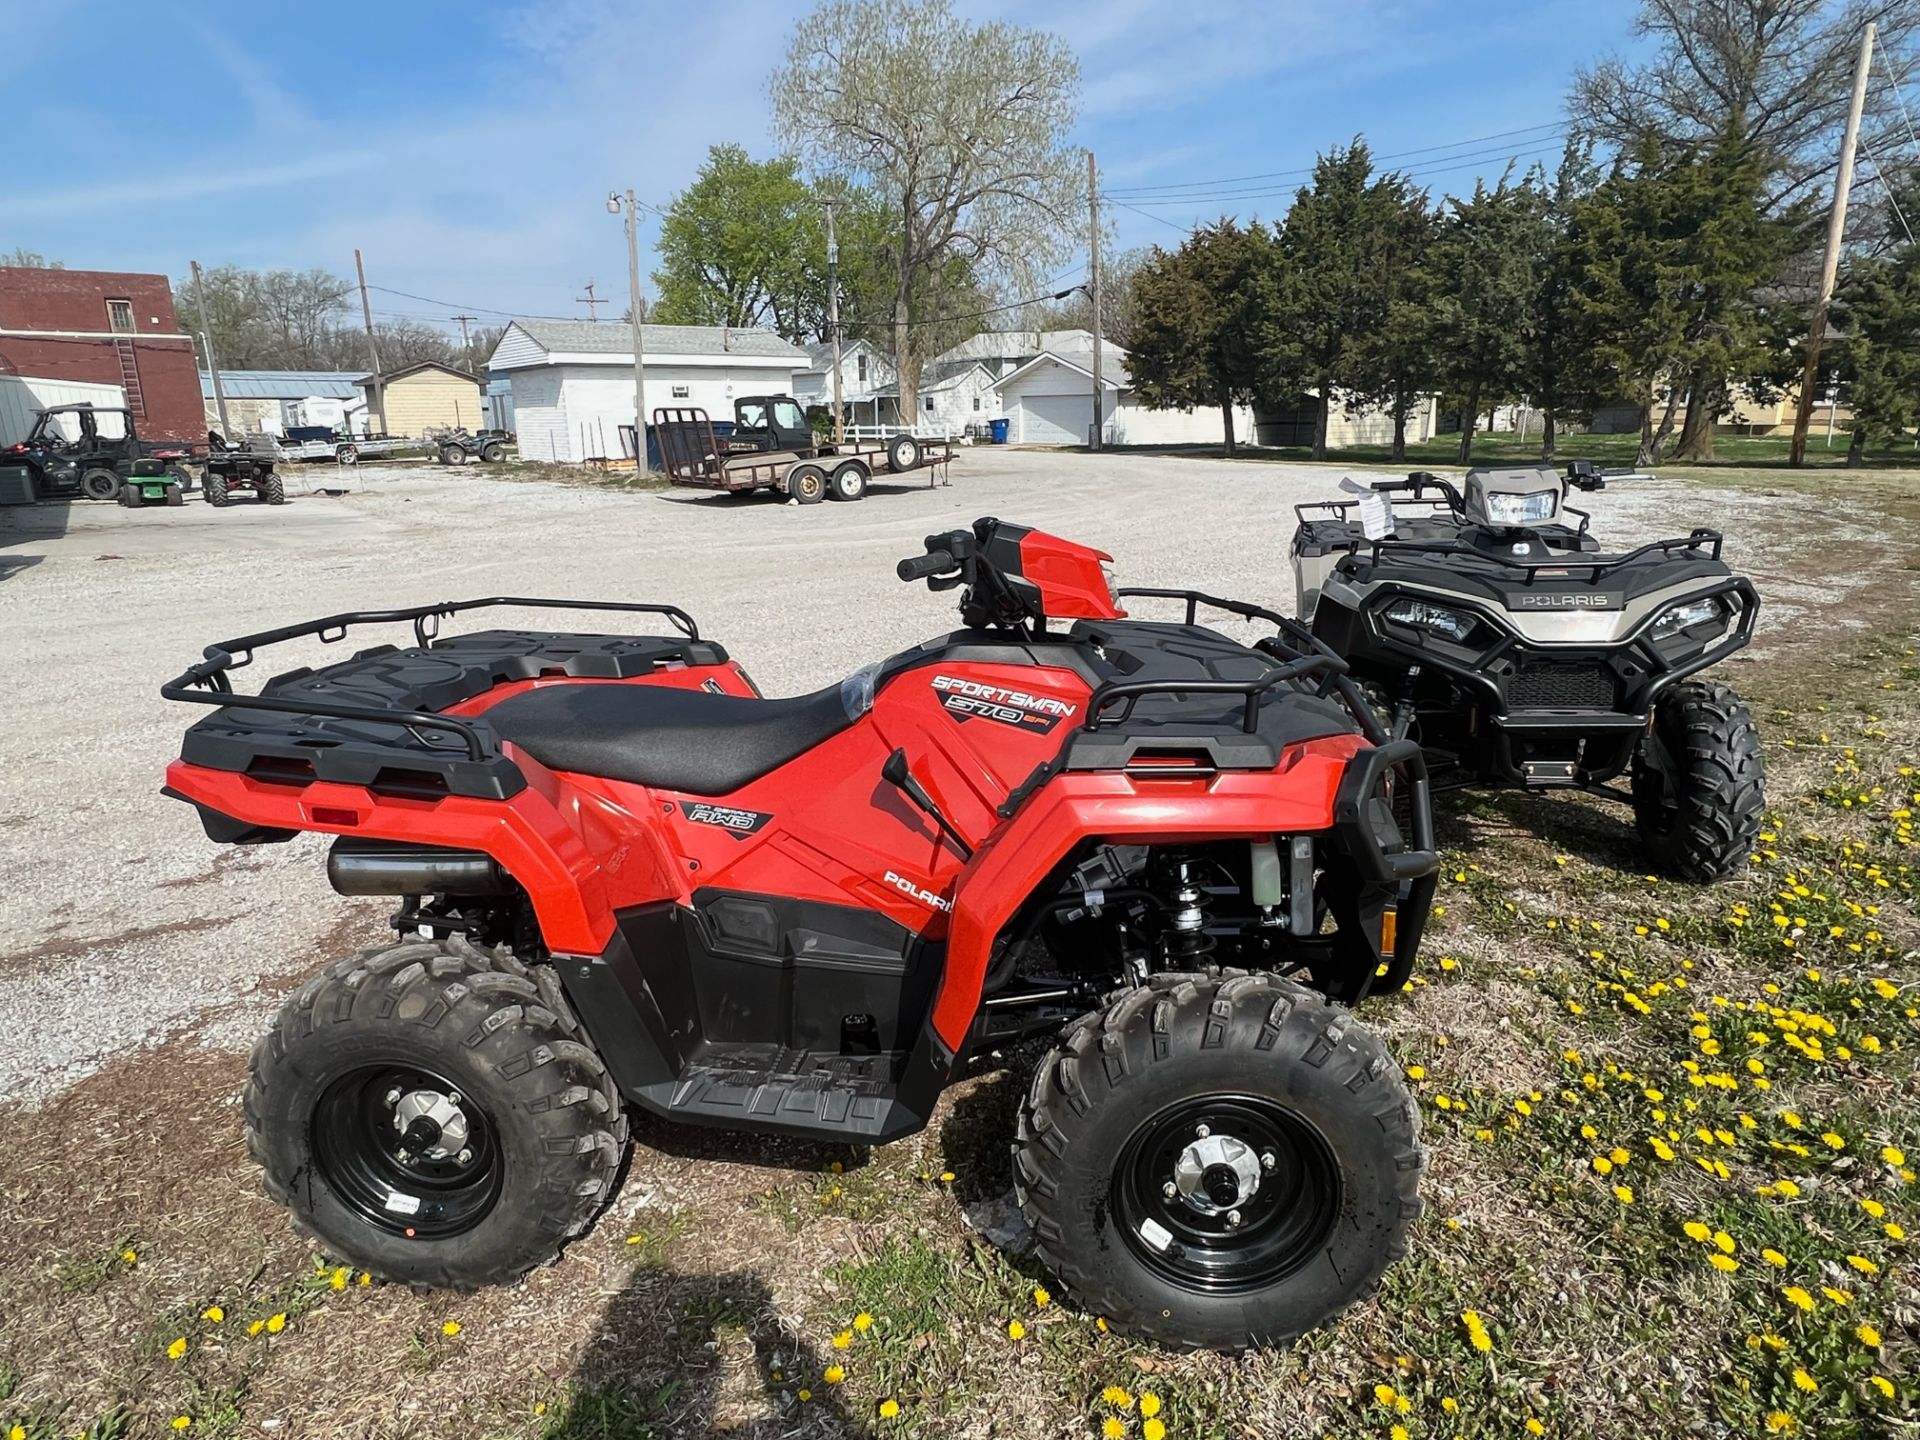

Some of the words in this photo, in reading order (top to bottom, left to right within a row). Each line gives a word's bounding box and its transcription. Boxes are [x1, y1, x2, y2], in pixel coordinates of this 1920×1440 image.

[1522, 595, 1608, 606] POLARIS
[930, 675, 1077, 717] SPORTSMAN
[944, 694, 1025, 724] 570
[689, 809, 755, 830] AWD
[883, 870, 952, 914] POLARI
